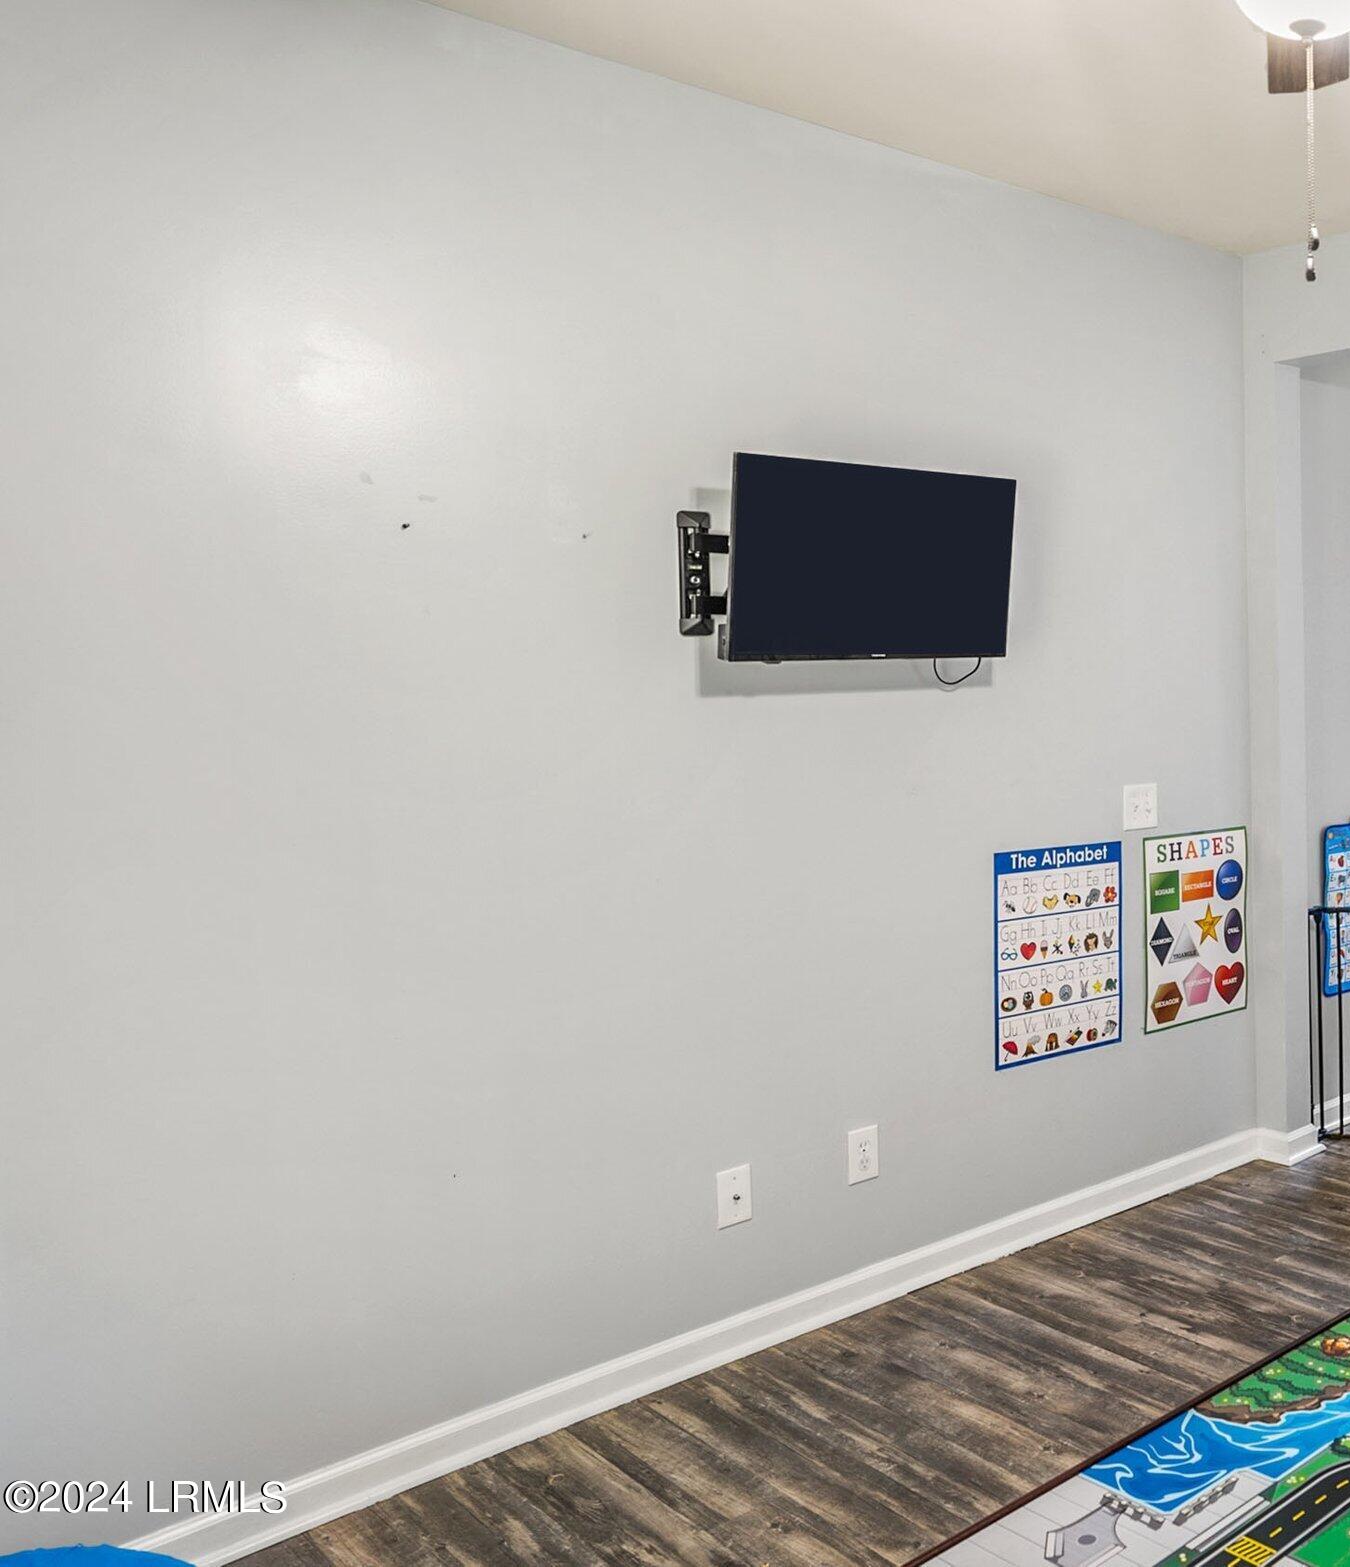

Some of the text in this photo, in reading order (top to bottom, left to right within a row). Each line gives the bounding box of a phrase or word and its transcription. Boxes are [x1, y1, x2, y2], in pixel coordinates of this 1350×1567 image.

[1010, 845, 1108, 869] The Alphabet
[1156, 836, 1235, 863] SHAPES
[1001, 880, 1018, 896] Aa
[1023, 877, 1038, 894] Bb
[1043, 875, 1059, 891] Cc
[1064, 872, 1080, 889] Dd
[1221, 876, 1238, 884] CIRCLE
[1000, 925, 1017, 945] Gg
[1222, 977, 1238, 986] HEART
